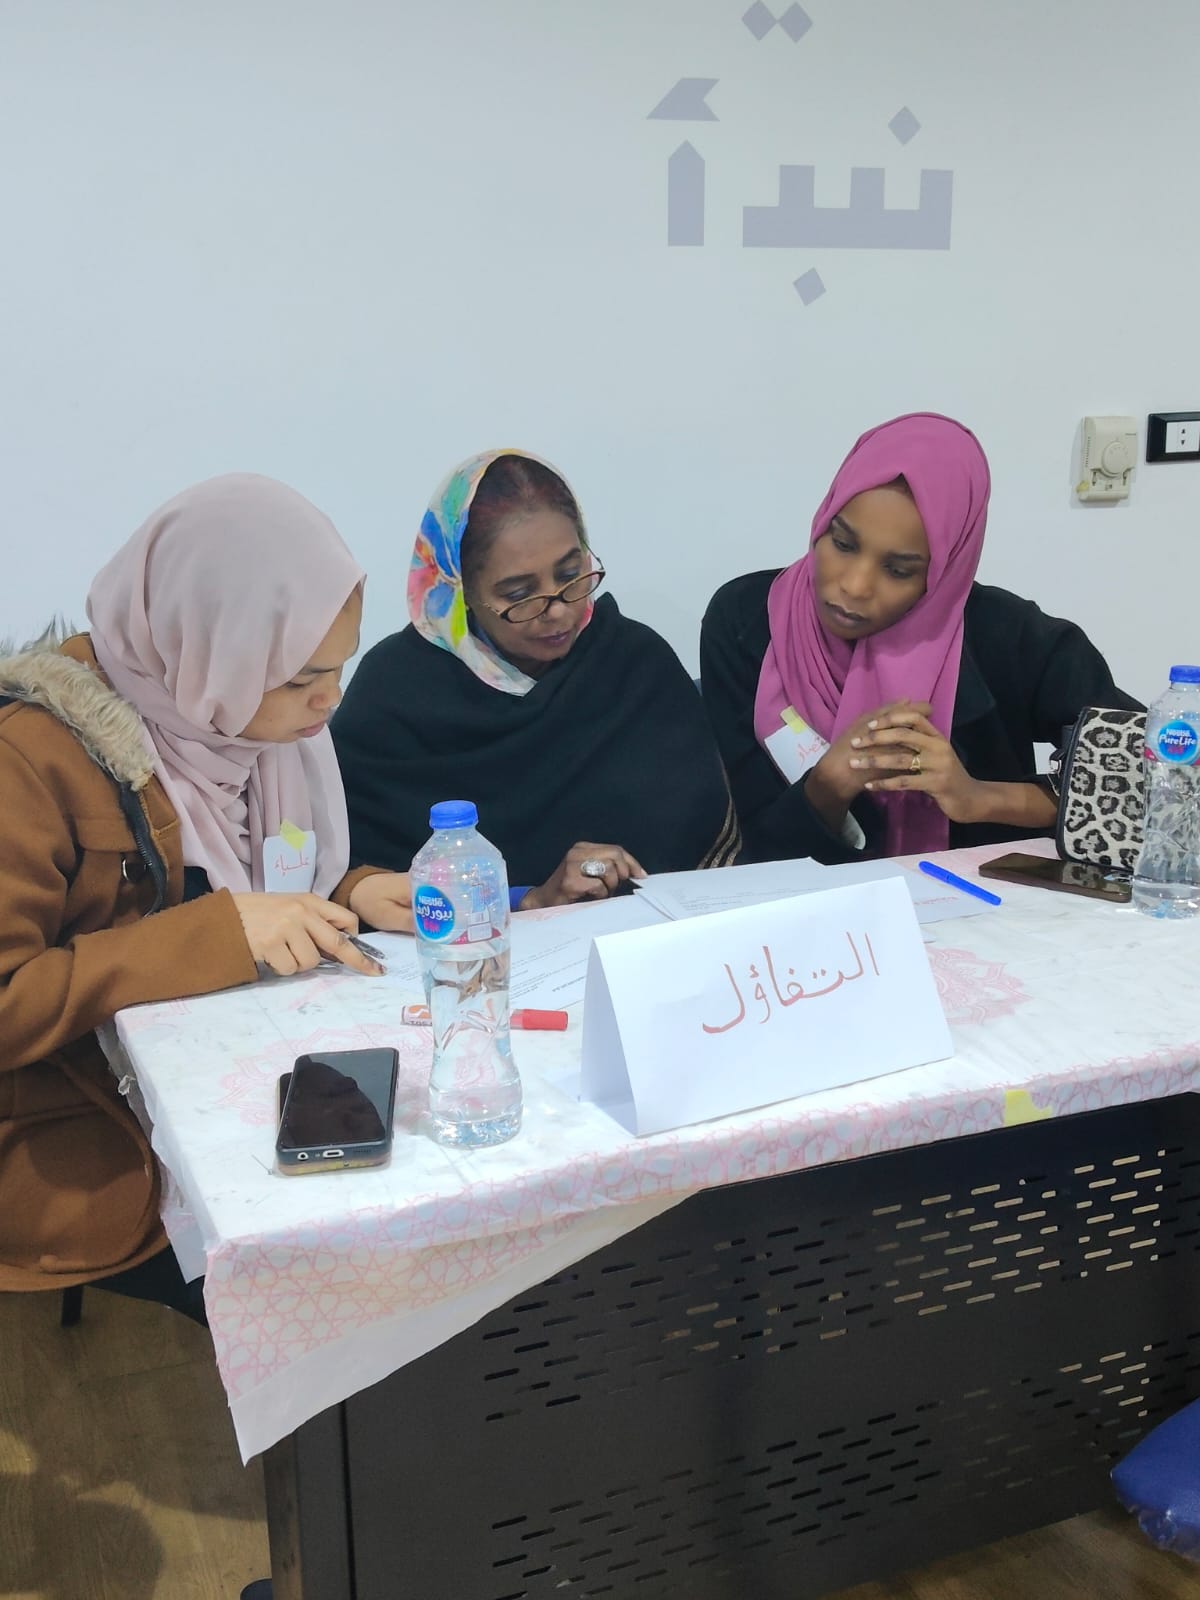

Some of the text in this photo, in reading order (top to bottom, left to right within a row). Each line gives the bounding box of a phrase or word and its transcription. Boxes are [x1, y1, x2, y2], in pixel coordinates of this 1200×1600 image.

[1158, 734, 1197, 747] Pure Life
[702, 931, 880, 1035] التفاؤل
